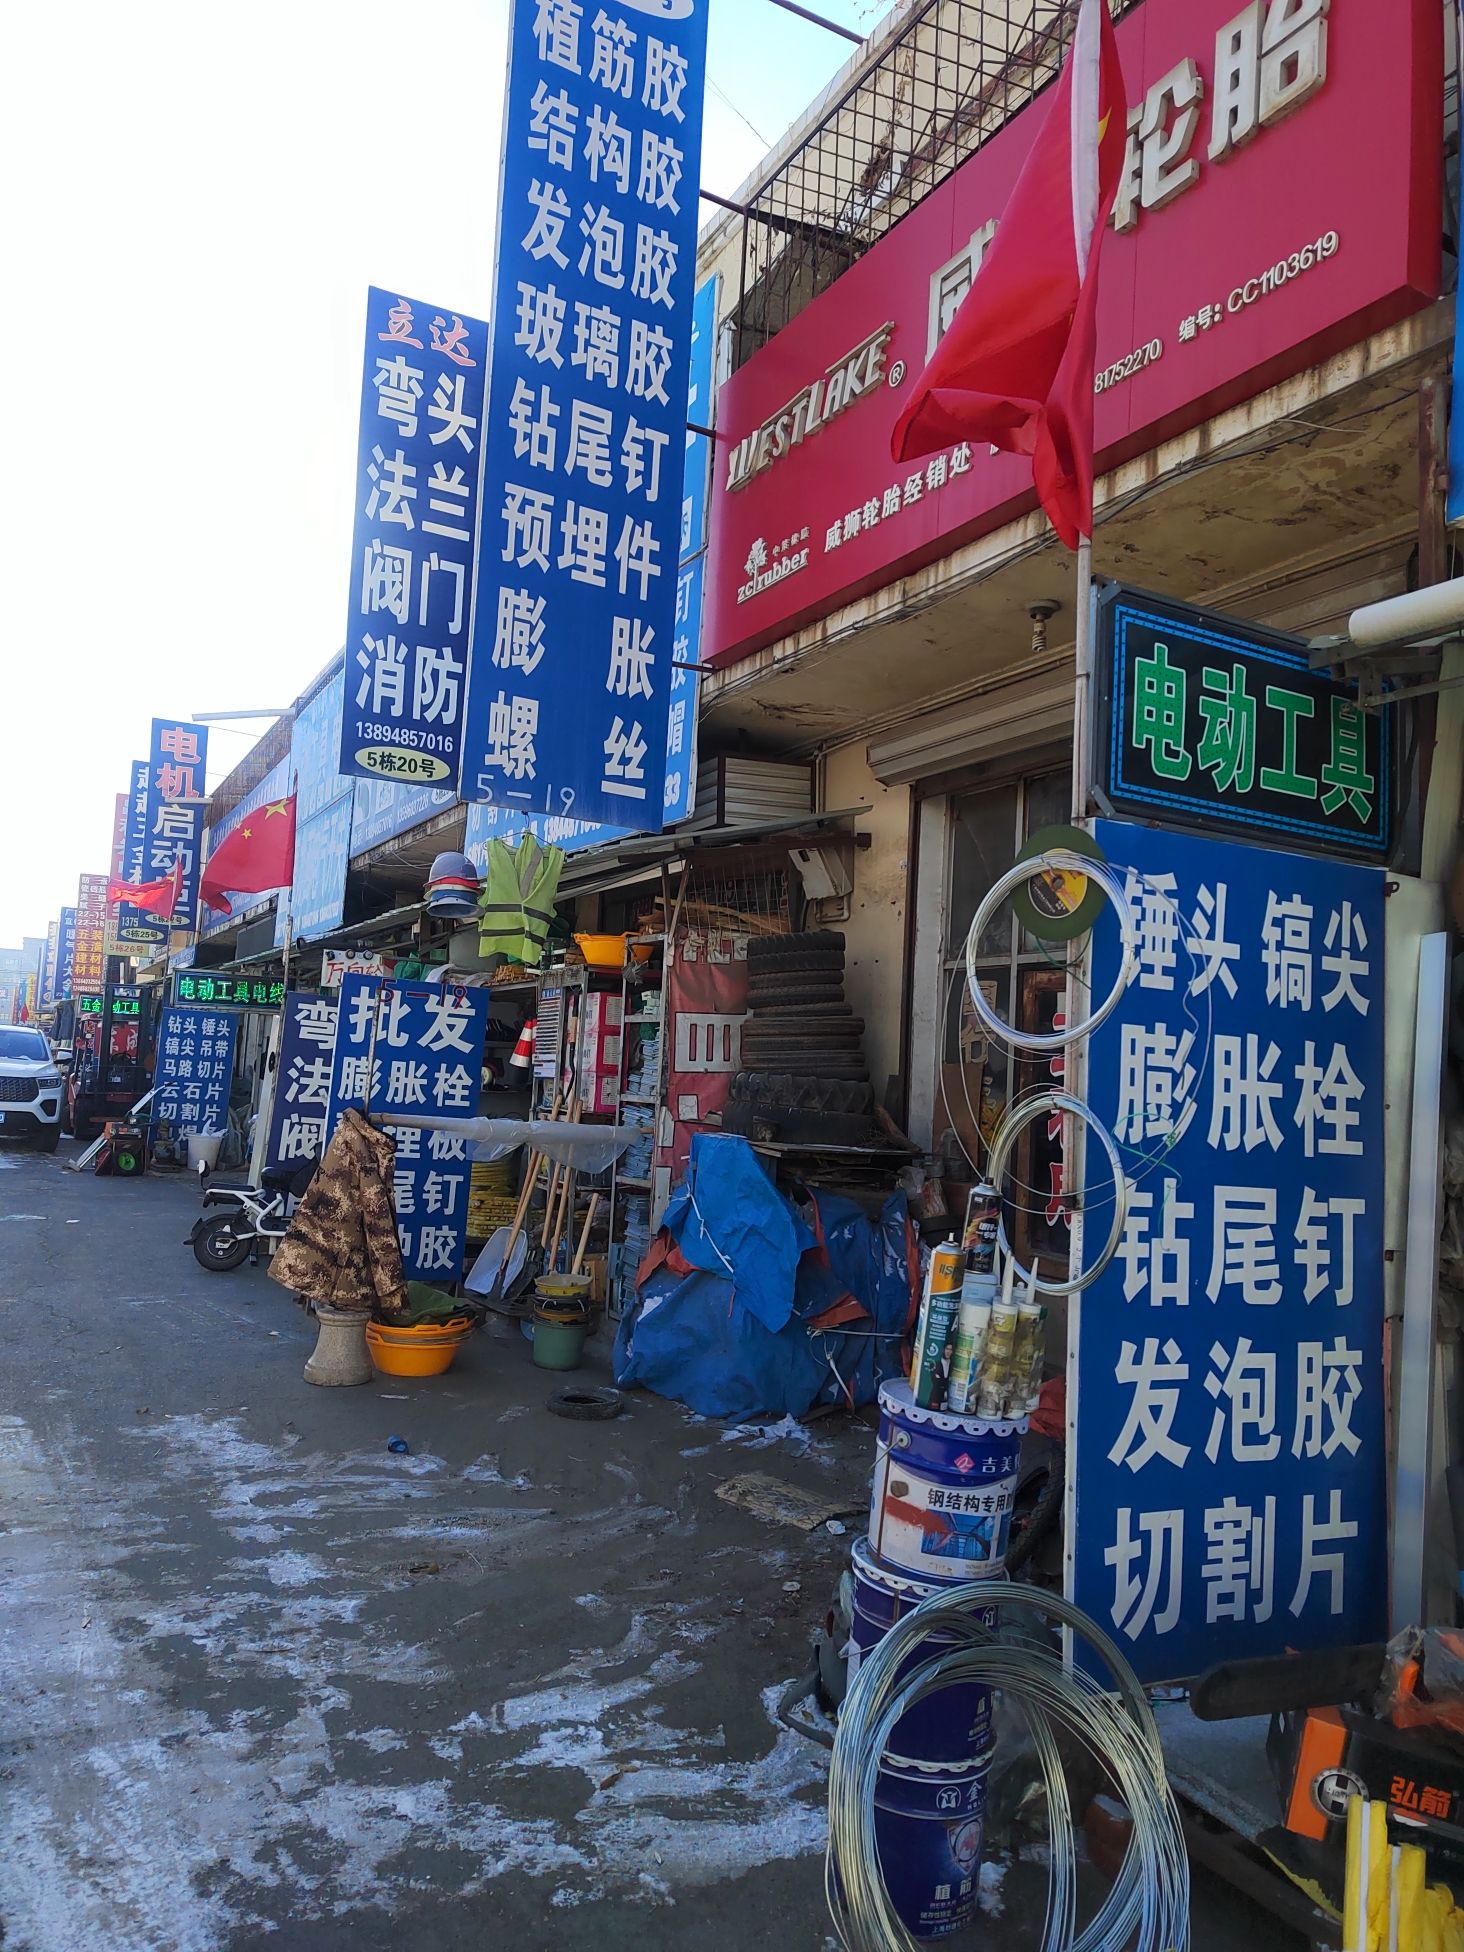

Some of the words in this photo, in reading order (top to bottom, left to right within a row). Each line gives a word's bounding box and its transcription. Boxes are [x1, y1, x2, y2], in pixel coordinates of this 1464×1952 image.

[532, 0, 688, 123] 植筋胶
[528, 80, 684, 215] 结构胶
[521, 179, 679, 310] 发泡胶
[378, 298, 476, 367] 立达
[514, 280, 673, 407] 玻璃胶
[372, 356, 477, 454] 弯头
[508, 377, 669, 502] 钻尾钉
[726, 320, 895, 492] WESTLAKE
[365, 444, 471, 542] 法兰
[501, 482, 661, 601] 预埋件
[824, 441, 972, 553] 威狮轮胎经销处
[360, 538, 465, 635] 阀门
[355, 632, 463, 725] 消防
[355, 721, 454, 753] 13894857016
[366, 751, 437, 779] 5栋20号
[1132, 642, 1375, 824] 电动工具
[126, 929, 158, 940] 5栋25号
[1121, 866, 1241, 1000] 锤头
[1261, 889, 1371, 1017] 镐尖
[167, 1015, 197, 1035] 钻头
[201, 1018, 231, 1037] 锤头
[179, 977, 285, 1004] 电动工具电线
[349, 986, 475, 1054] 批发
[161, 1082, 223, 1100] 云石片
[165, 1037, 195, 1056] 镐尖
[200, 1039, 229, 1058] 吊带
[337, 1056, 474, 1108] 膨胀栓
[1113, 1022, 1366, 1157] 膨胀栓
[158, 1102, 221, 1122] 切割片
[394, 1170, 464, 1216] 尾钉
[1115, 1176, 1366, 1307] 钻尾钉
[1107, 1336, 1363, 1473] 发泡胶
[1104, 1489, 1359, 1642] 切割片
[1390, 1776, 1452, 1819] 弘箭
